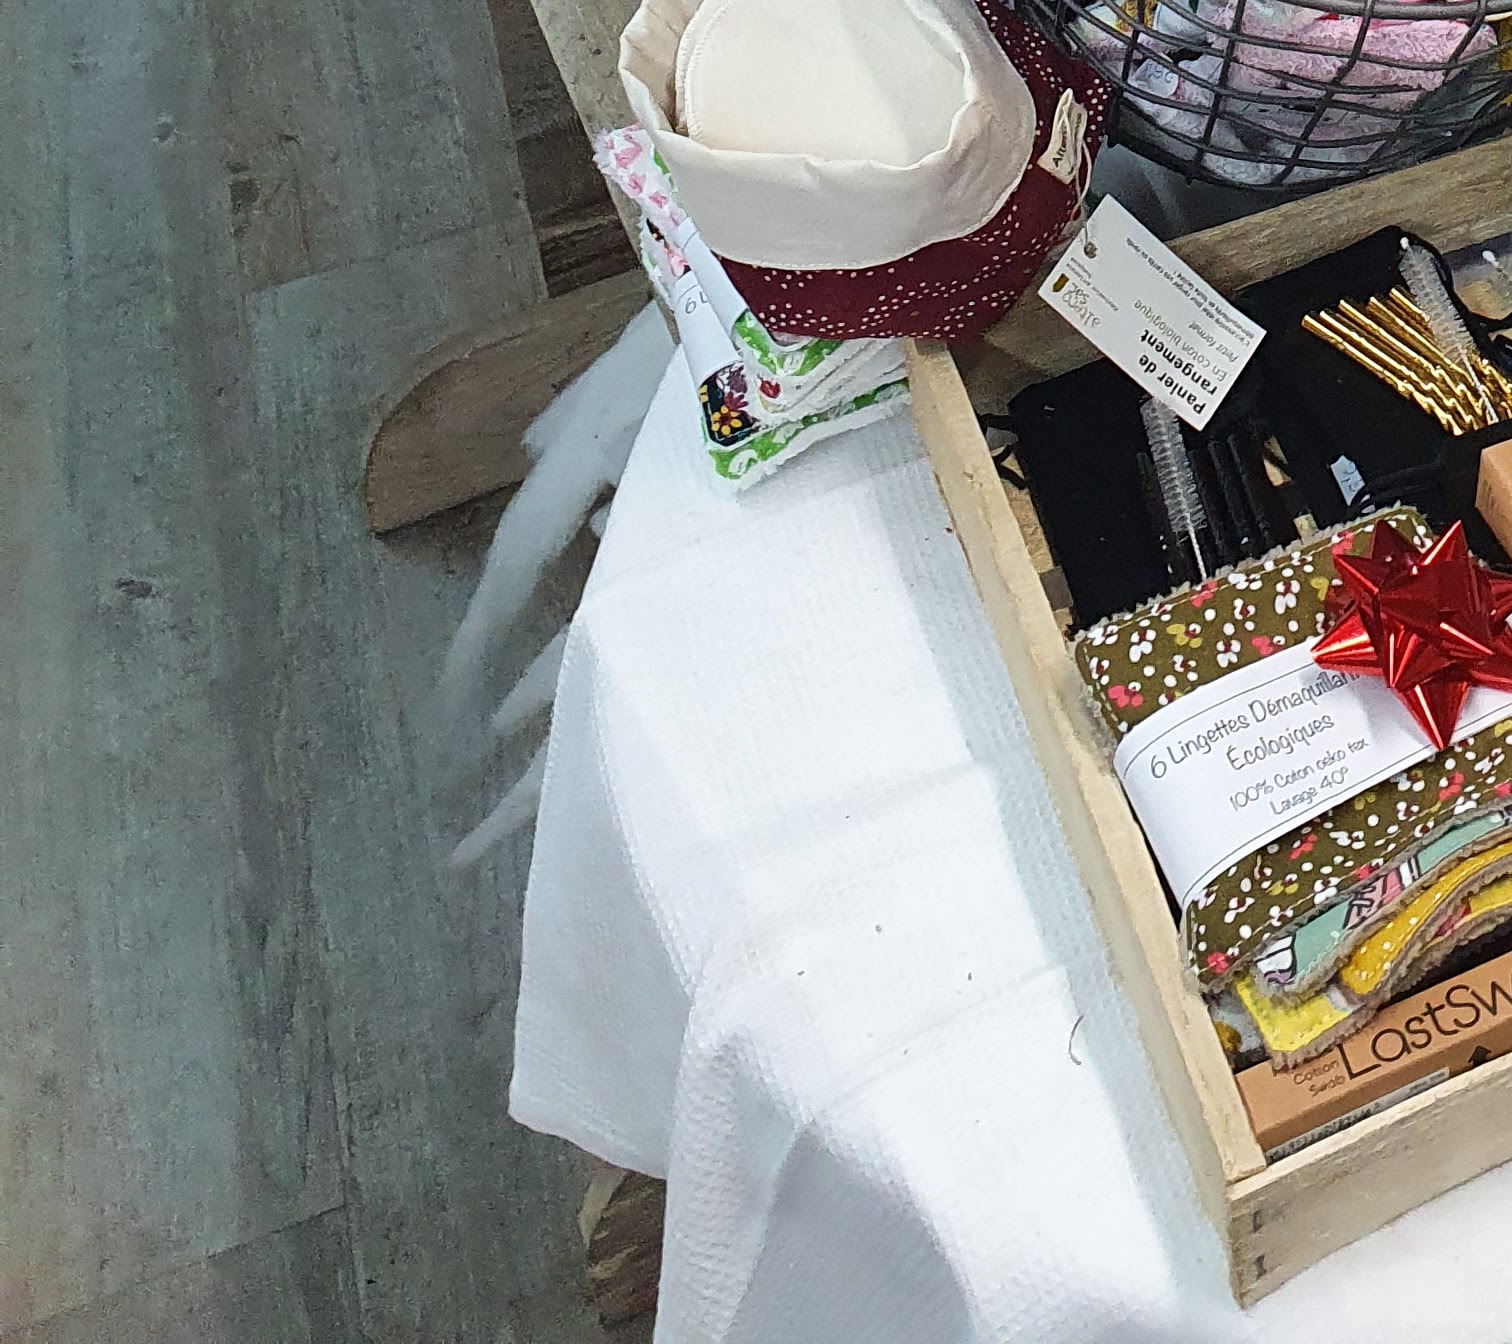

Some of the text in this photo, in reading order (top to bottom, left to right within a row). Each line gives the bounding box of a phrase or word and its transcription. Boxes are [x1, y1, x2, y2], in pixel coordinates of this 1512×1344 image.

[1134, 299, 1228, 382] En coton biologique
[1141, 328, 1218, 396] rangement
[1138, 354, 1206, 415] Panier de
[1150, 671, 1361, 779] 6 Lingettes Démaquillan
[1225, 714, 1336, 771] Écologiques
[1230, 737, 1370, 812] 100% Coton oeko tex
[1269, 786, 1318, 815] Lavage
